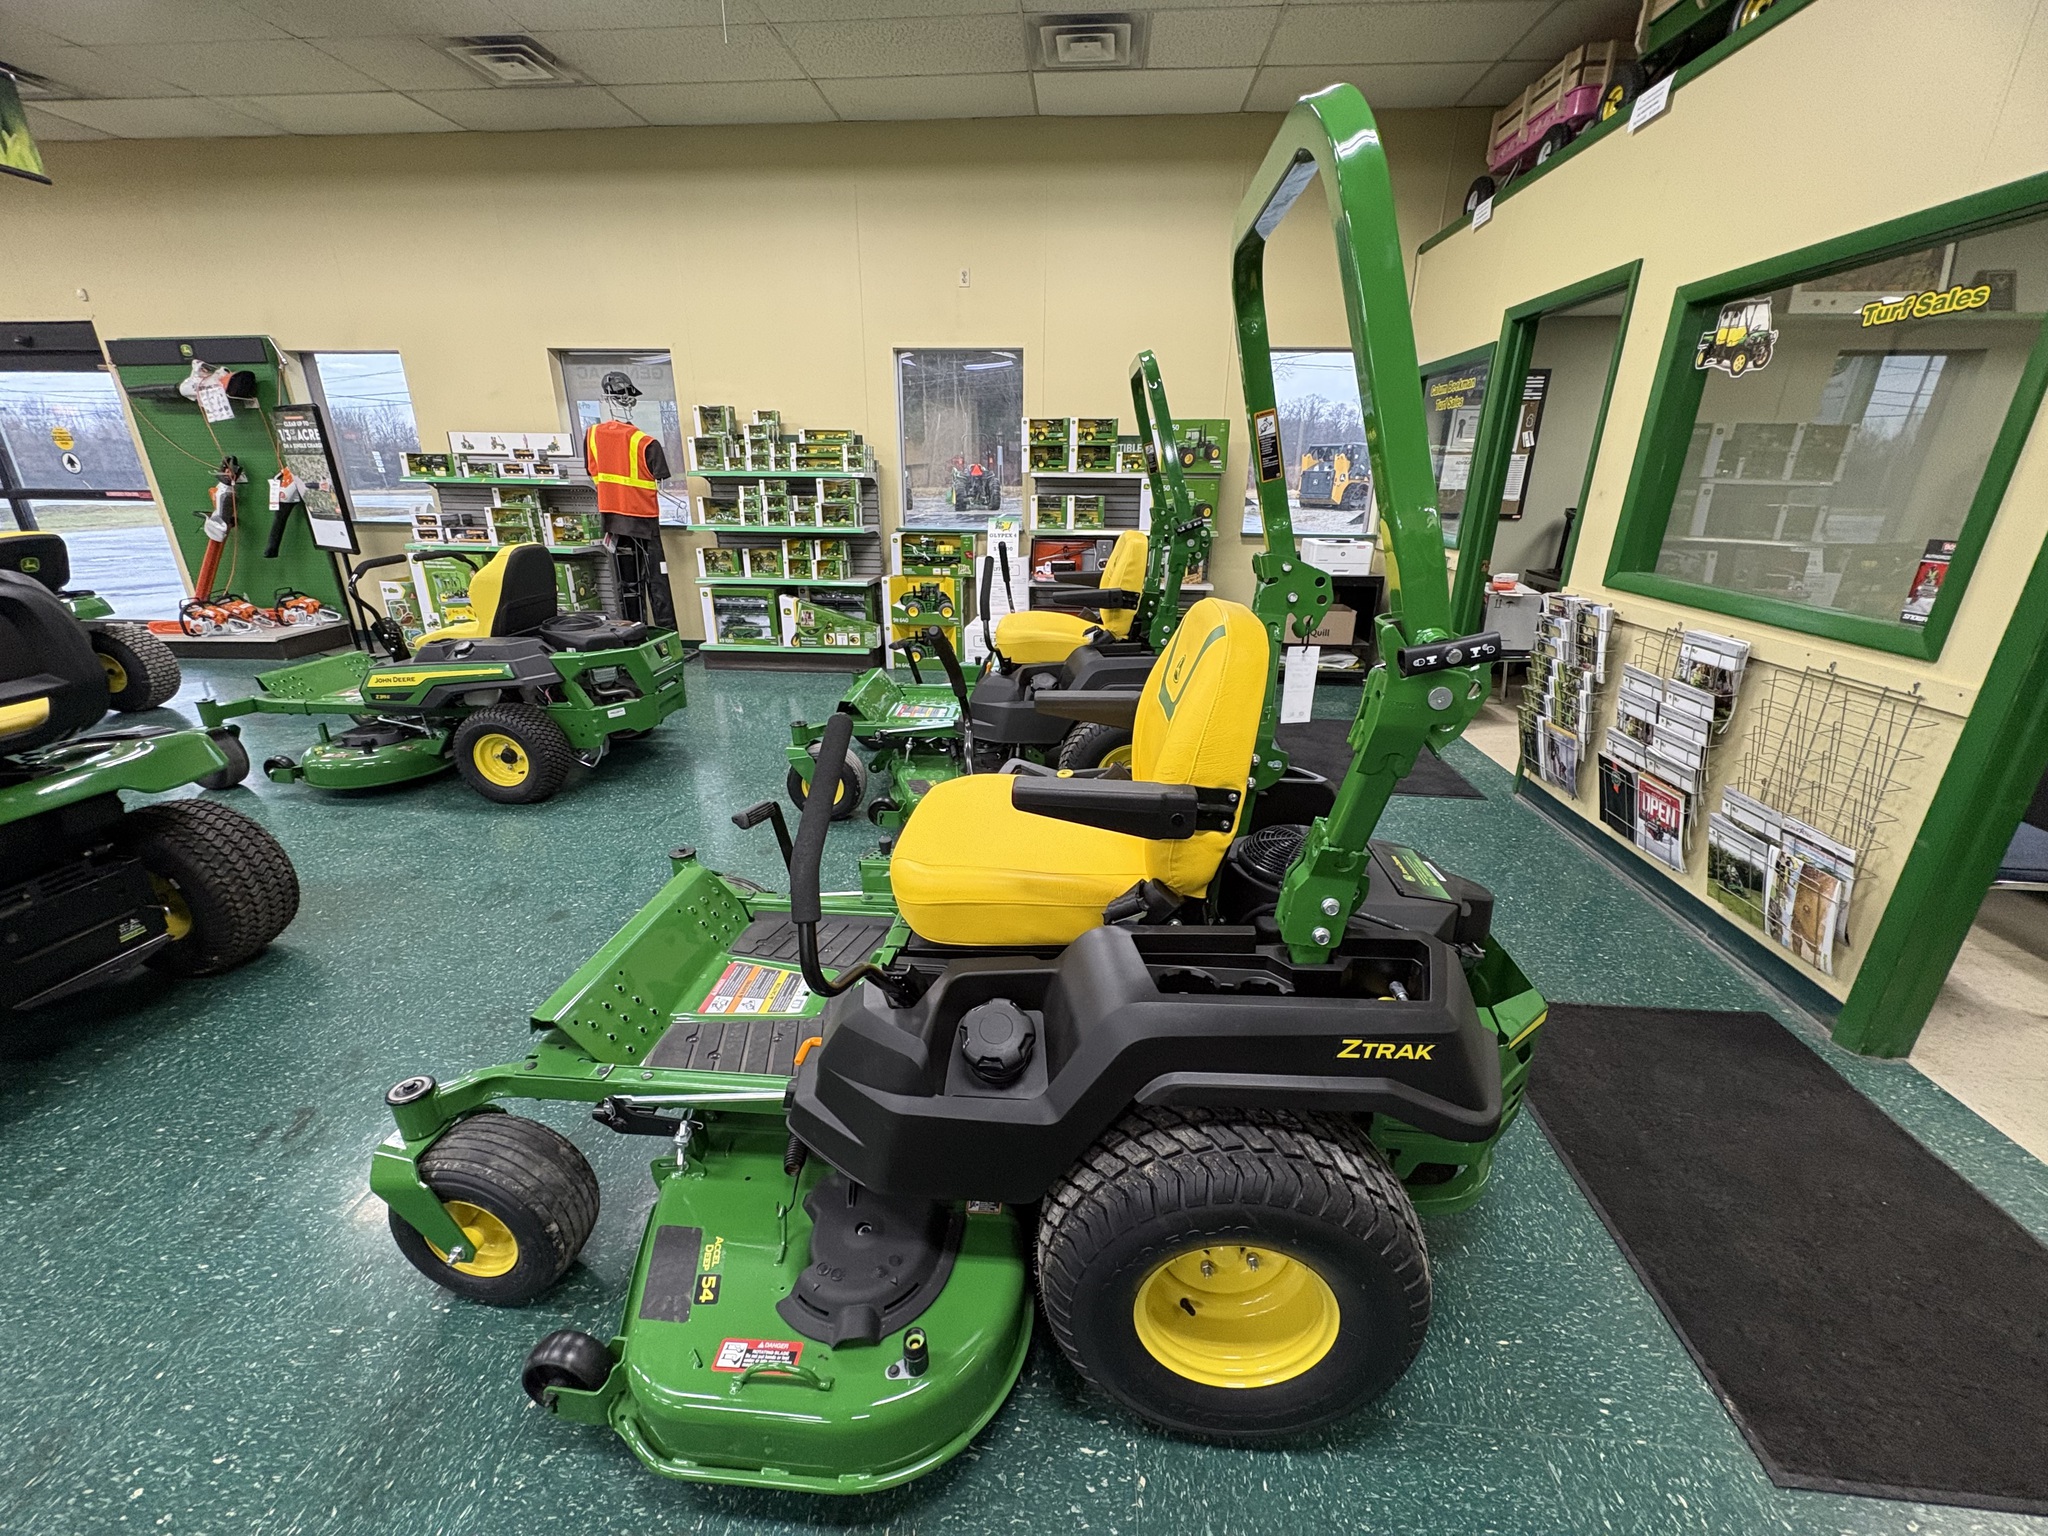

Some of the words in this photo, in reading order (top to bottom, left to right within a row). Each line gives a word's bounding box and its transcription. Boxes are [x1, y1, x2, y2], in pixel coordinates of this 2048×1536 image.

[1862, 293, 1917, 327] Turf
[1912, 285, 1991, 317] Sales
[297, 428, 321, 441] ACRE
[1120, 444, 1142, 453] TIBLE
[1310, 629, 1331, 638] Quill
[1336, 1038, 1437, 1061] ZTRAK
[703, 1244, 714, 1271] DEEP
[712, 1236, 724, 1268] ACCEL
[699, 1276, 716, 1303] 54
[764, 1342, 790, 1350] DANGER
